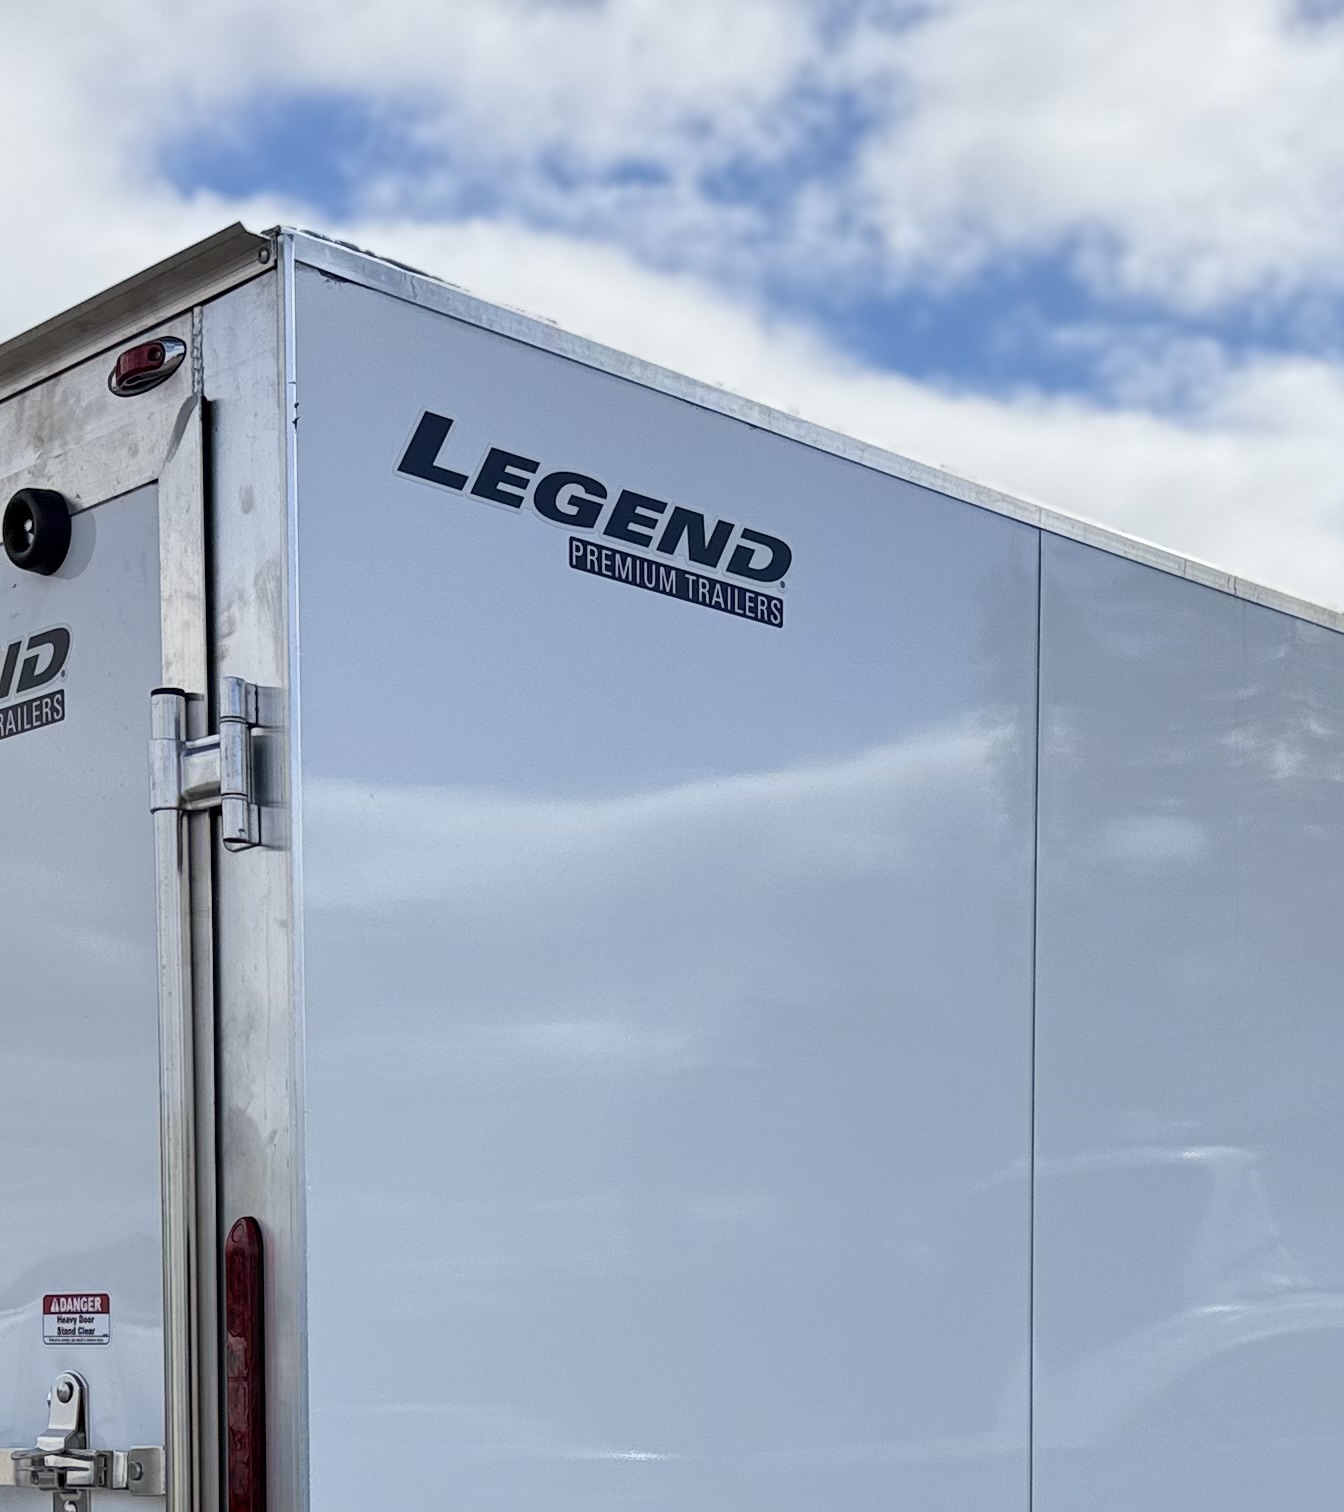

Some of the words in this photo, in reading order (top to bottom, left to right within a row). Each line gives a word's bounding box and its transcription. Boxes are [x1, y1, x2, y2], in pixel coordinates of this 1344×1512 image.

[396, 410, 793, 583] LEGEND
[571, 540, 677, 595] PREMIUM
[684, 573, 782, 626] TRAILERS
[59, 1296, 102, 1312] DANGER
[57, 1315, 77, 1325] Heavy
[57, 1326, 76, 1335] Stand
[77, 1326, 96, 1335] Clear
